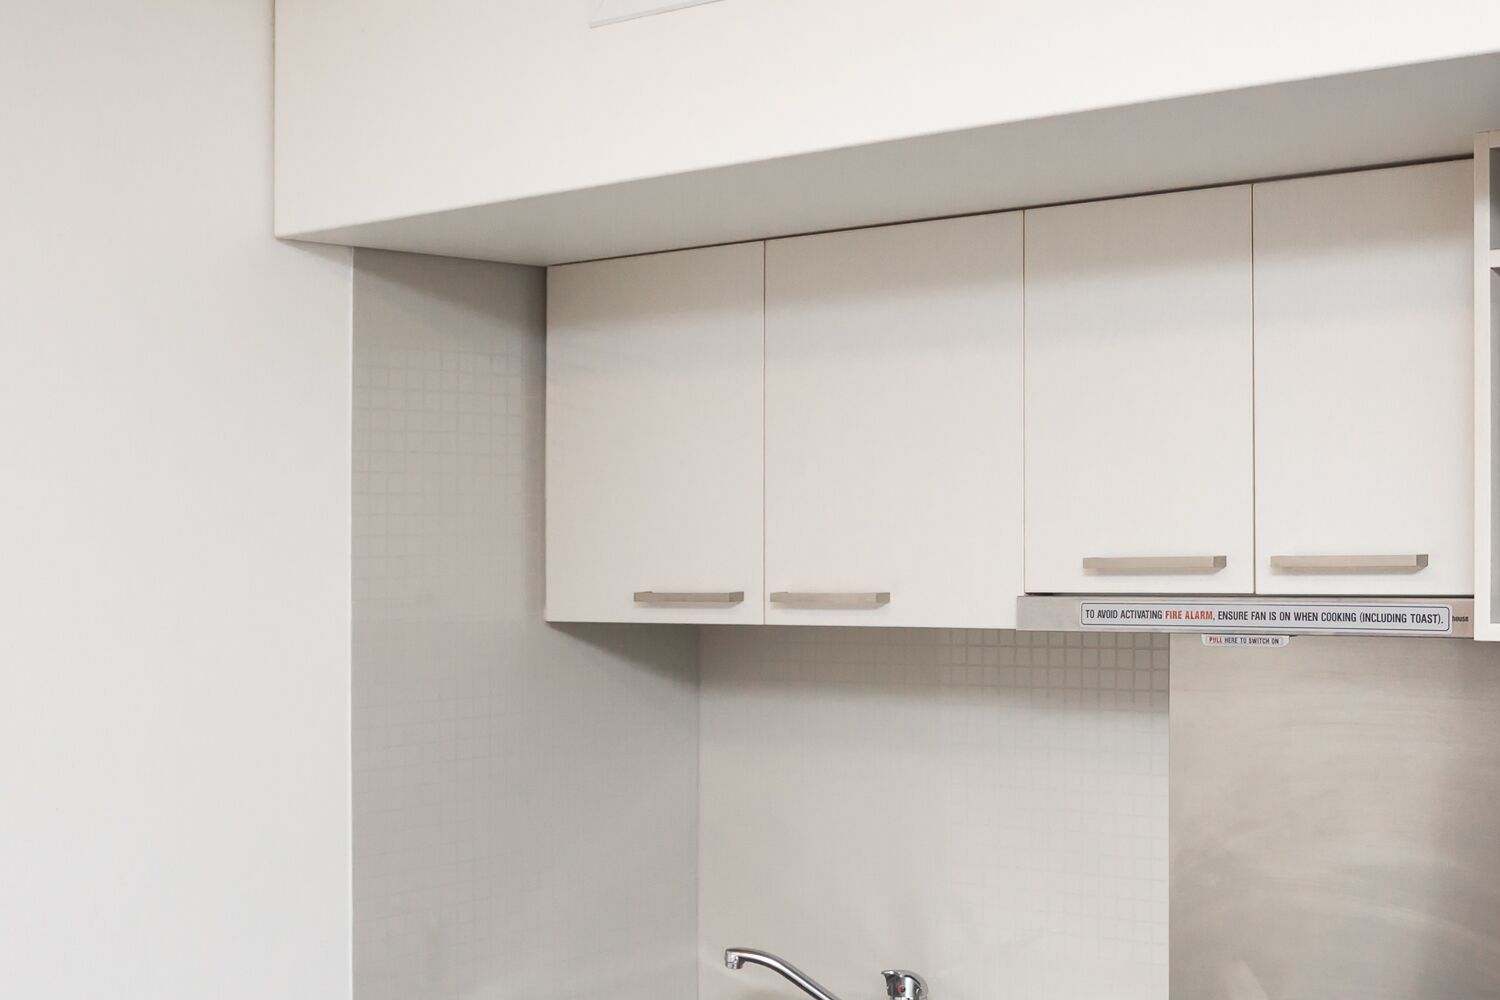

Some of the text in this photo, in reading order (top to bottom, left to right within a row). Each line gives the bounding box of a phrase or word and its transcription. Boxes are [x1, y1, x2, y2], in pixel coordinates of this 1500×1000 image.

[1085, 609, 1444, 624] TO AVOID ACTIVATING FIRE ALARM, ENSURE FAN IS ON WHEN COOKING (INCLUDING TOAST).
